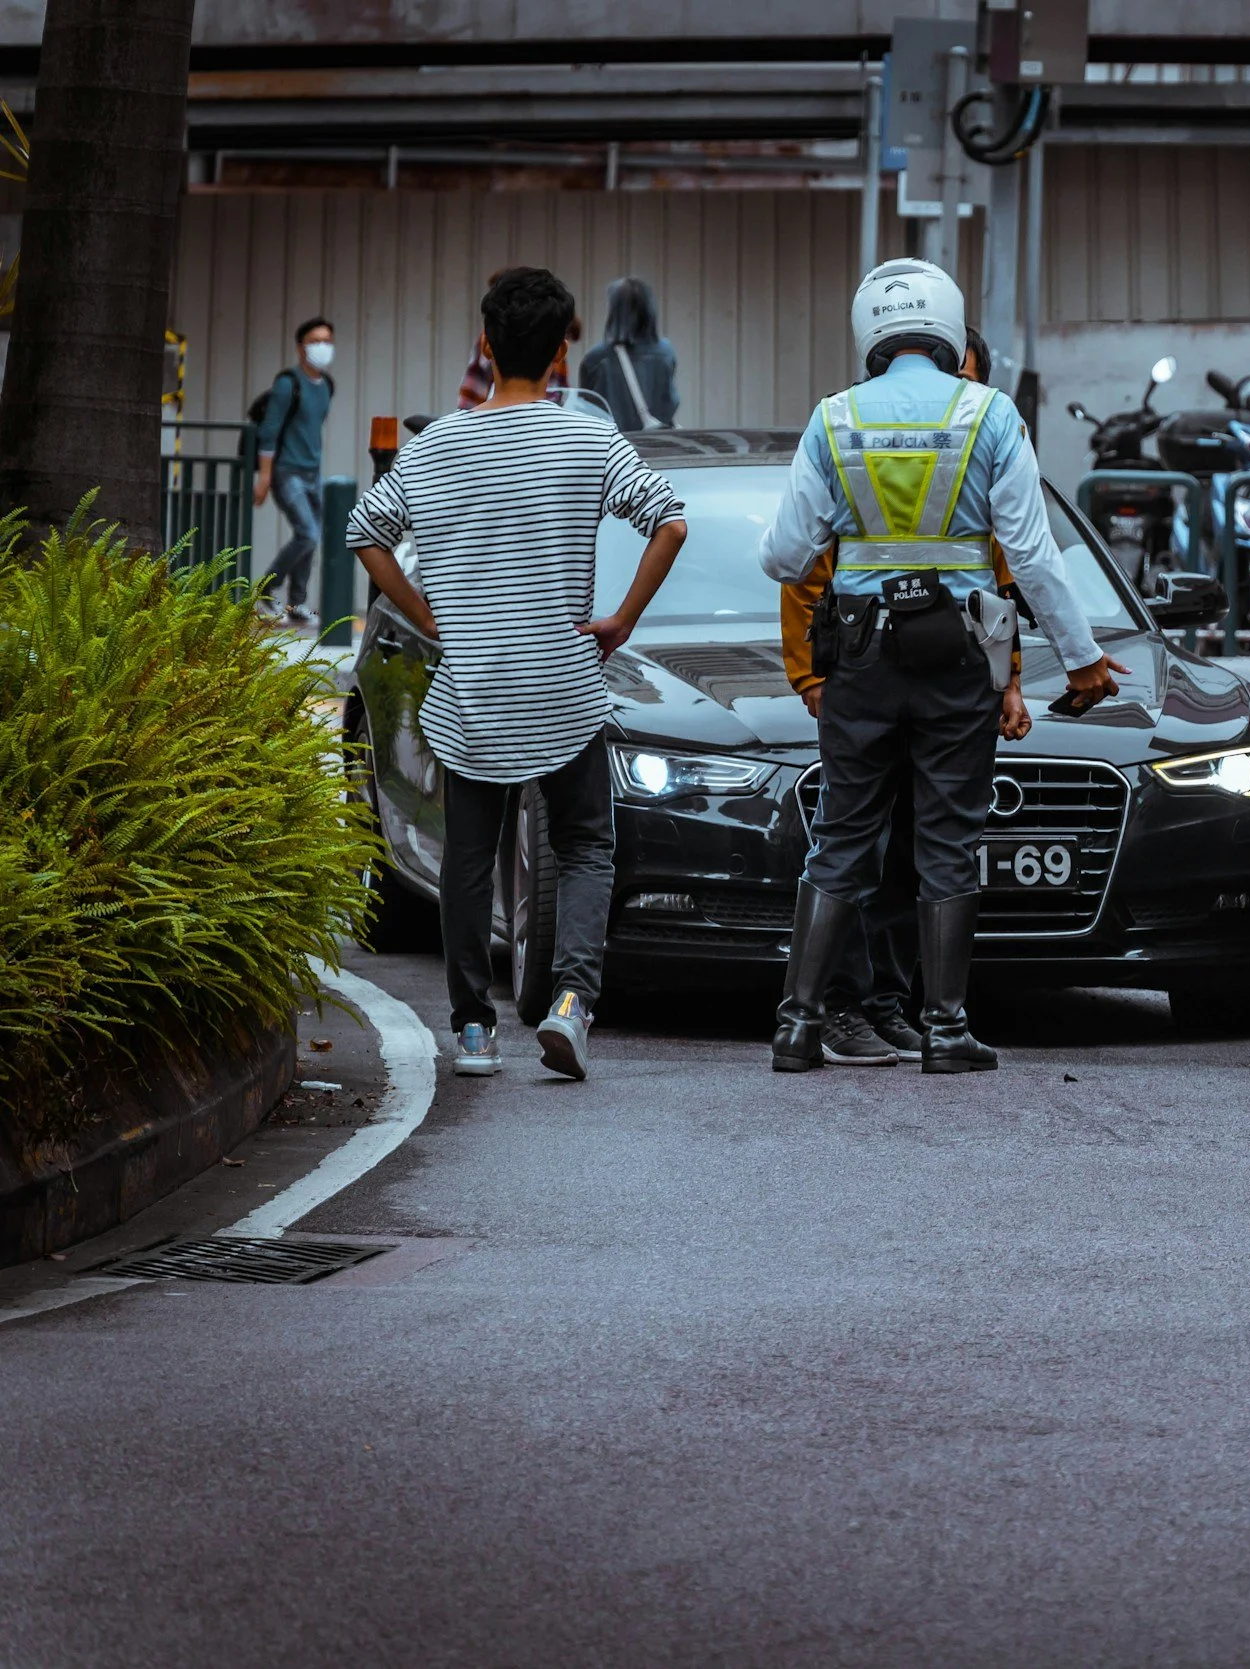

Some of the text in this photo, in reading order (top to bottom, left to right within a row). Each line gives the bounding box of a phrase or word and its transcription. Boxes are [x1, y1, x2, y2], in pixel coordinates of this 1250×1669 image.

[882, 302, 914, 314] POLÍCIA
[849, 431, 952, 449] 警 POLÍCIA 察
[893, 588, 930, 601] POLÍCIA
